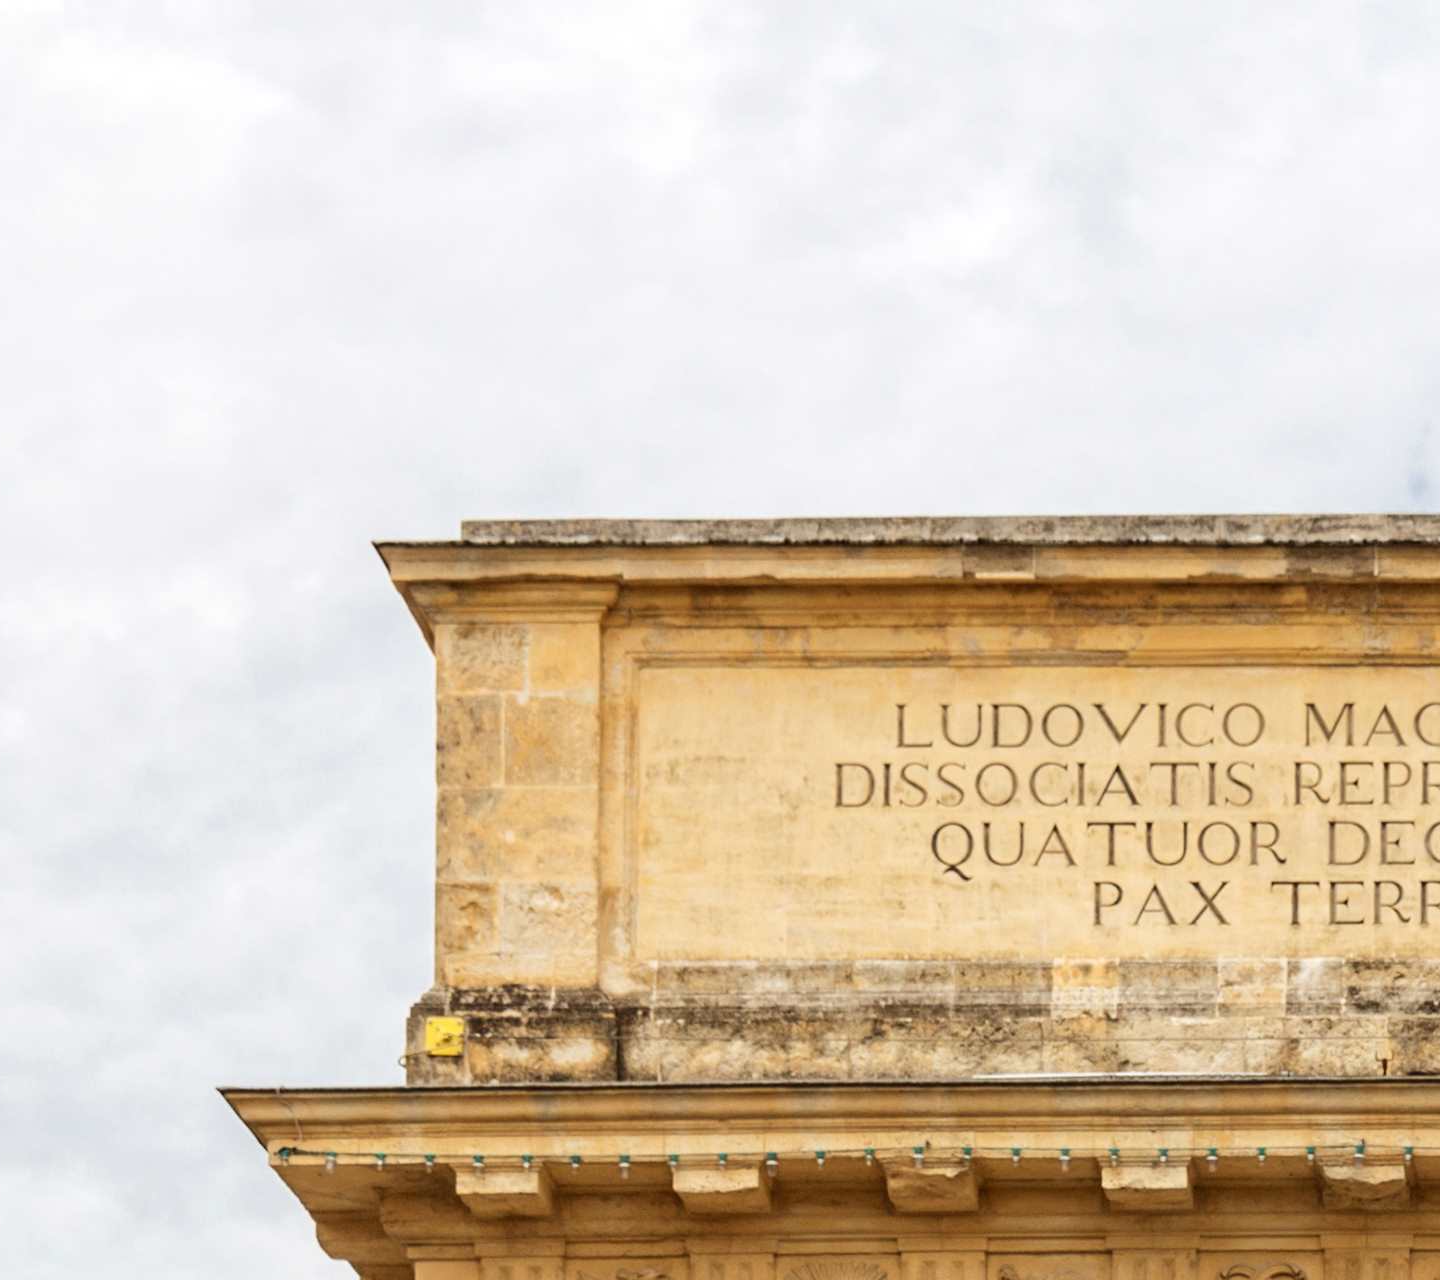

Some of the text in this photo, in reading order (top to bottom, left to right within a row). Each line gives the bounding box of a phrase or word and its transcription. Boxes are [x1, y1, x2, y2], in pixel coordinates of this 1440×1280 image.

[895, 702, 1266, 749] LUDOVICO
[834, 761, 1255, 808] DISSOCIATIS
[930, 820, 1288, 882] QUATUOR
[1093, 880, 1231, 927] PAX
